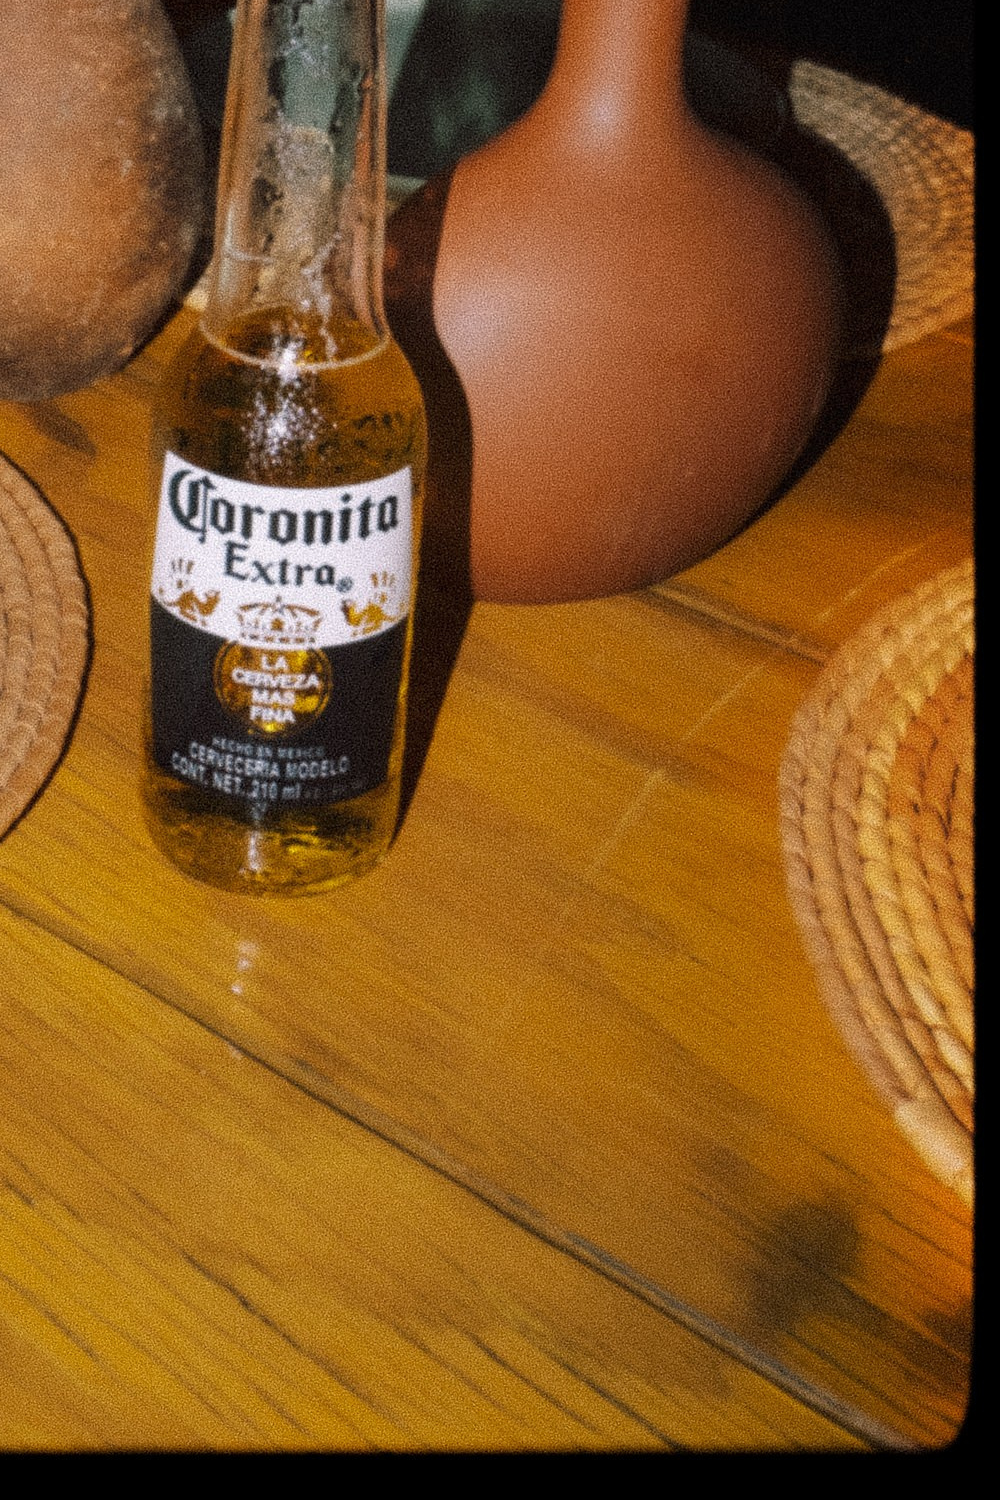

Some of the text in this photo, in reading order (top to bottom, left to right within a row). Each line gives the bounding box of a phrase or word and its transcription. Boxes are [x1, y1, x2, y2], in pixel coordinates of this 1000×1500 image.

[168, 469, 399, 545] Coronita
[261, 655, 288, 670] LA
[232, 669, 320, 688] CERVEZA
[251, 688, 296, 705] MAS
[250, 706, 296, 724] FINA
[212, 737, 253, 755] HECHO
[256, 744, 274, 758] EN
[189, 742, 349, 778] CERVECERIA MODELO
[171, 752, 208, 785] CONT.
[250, 779, 279, 800] 210
[282, 784, 301, 799] ml
